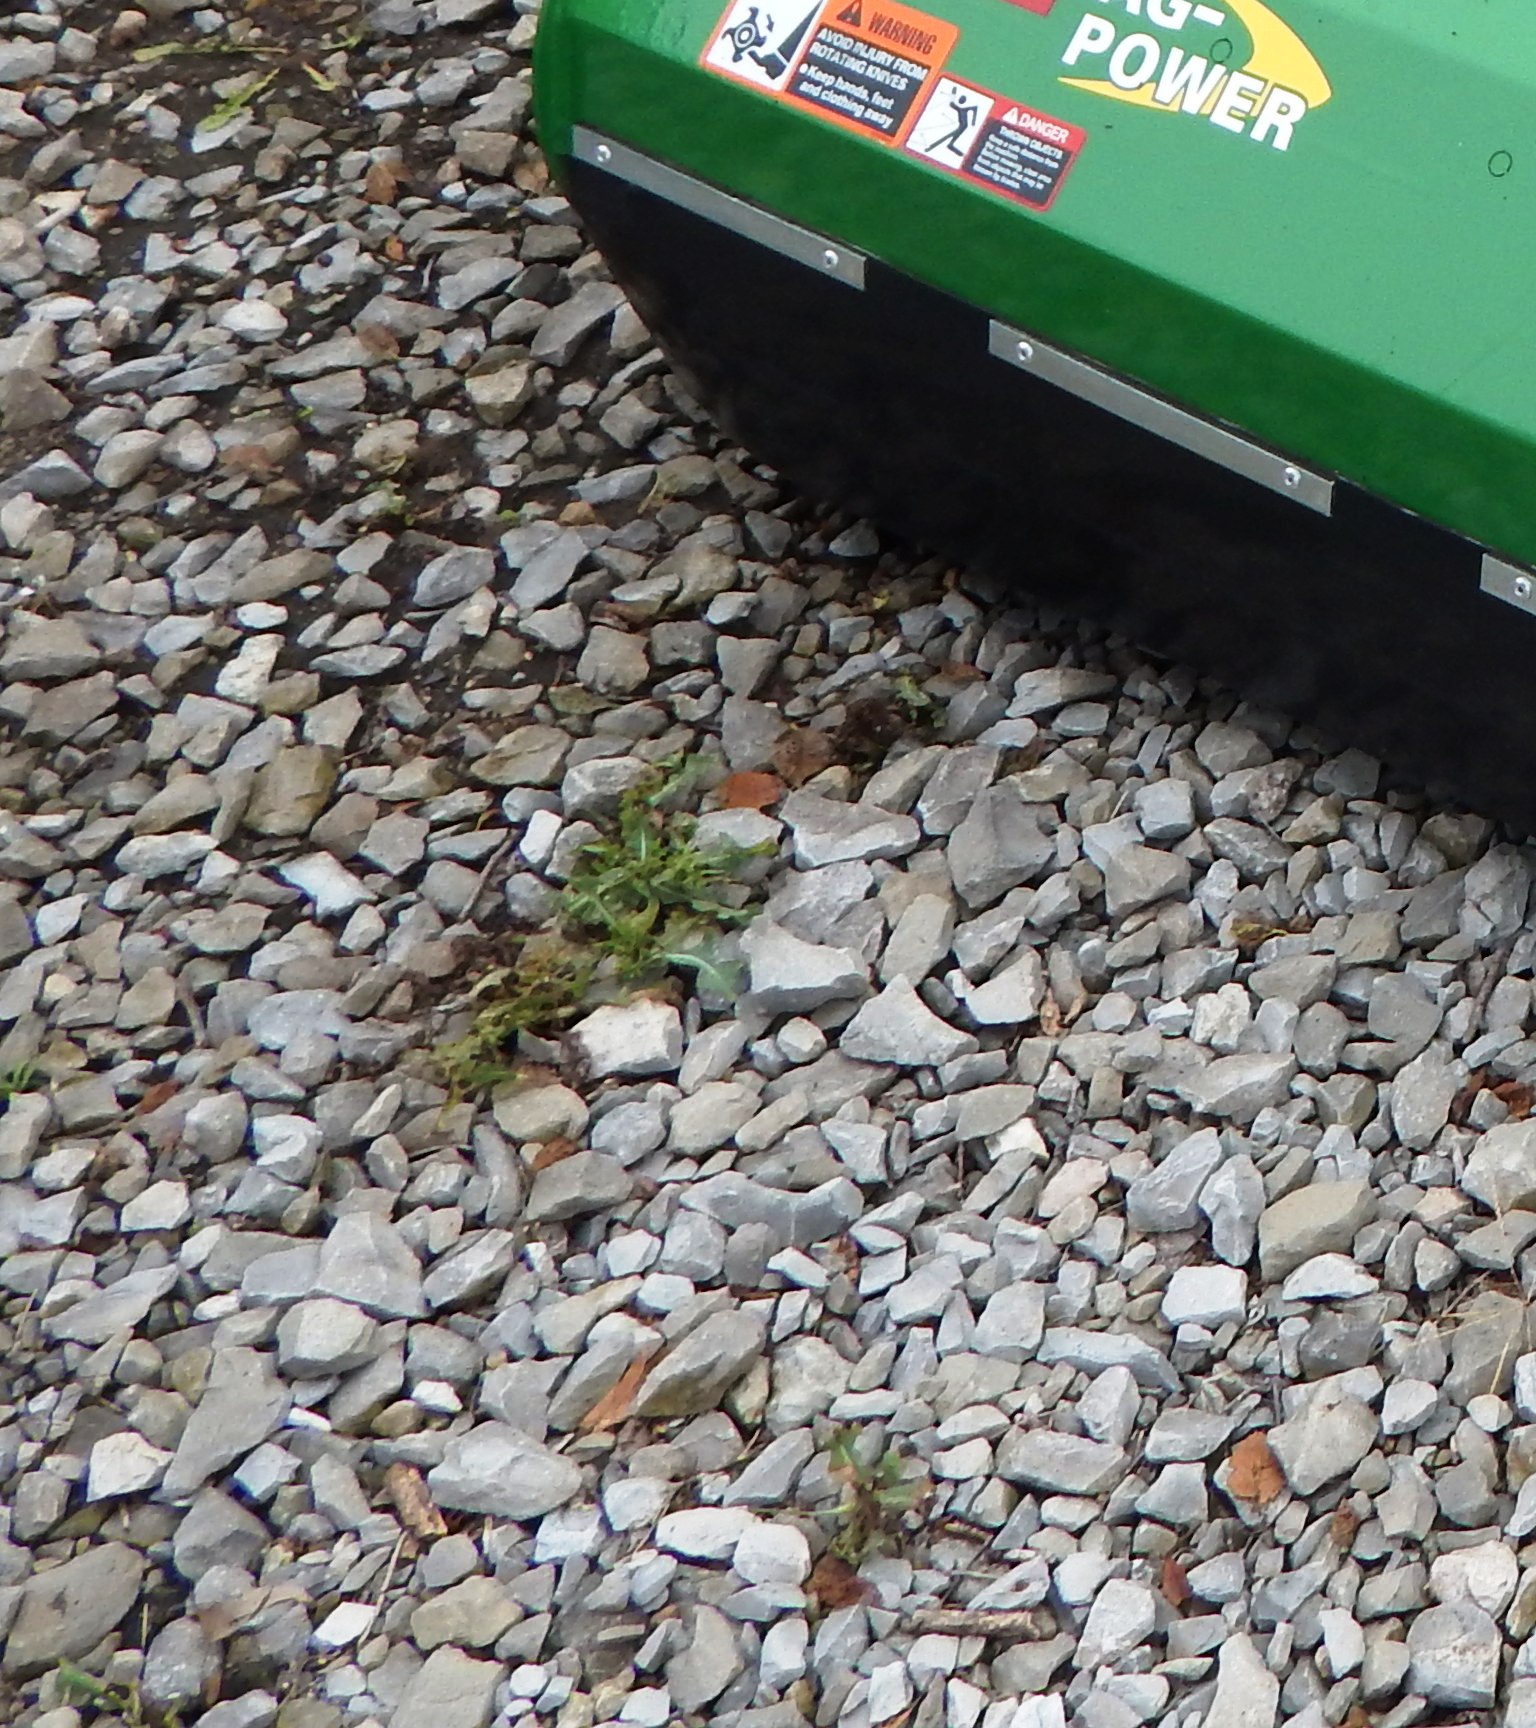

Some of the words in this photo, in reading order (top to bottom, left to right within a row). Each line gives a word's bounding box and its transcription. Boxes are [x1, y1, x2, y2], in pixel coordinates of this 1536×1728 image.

[817, 28, 854, 50] AVOID
[853, 41, 895, 67] INJURY
[893, 58, 929, 81] FROM
[868, 11, 937, 55] WARNING
[807, 65, 836, 87] Keep
[835, 76, 870, 102] hands,
[871, 91, 895, 110] feet
[809, 41, 868, 74] ROTATING
[866, 65, 909, 91] KNIVES
[1061, 13, 1308, 151] POWER
[799, 81, 822, 97] and
[821, 89, 865, 118] clothing
[864, 107, 894, 129] away
[1019, 112, 1070, 144] DANGER
